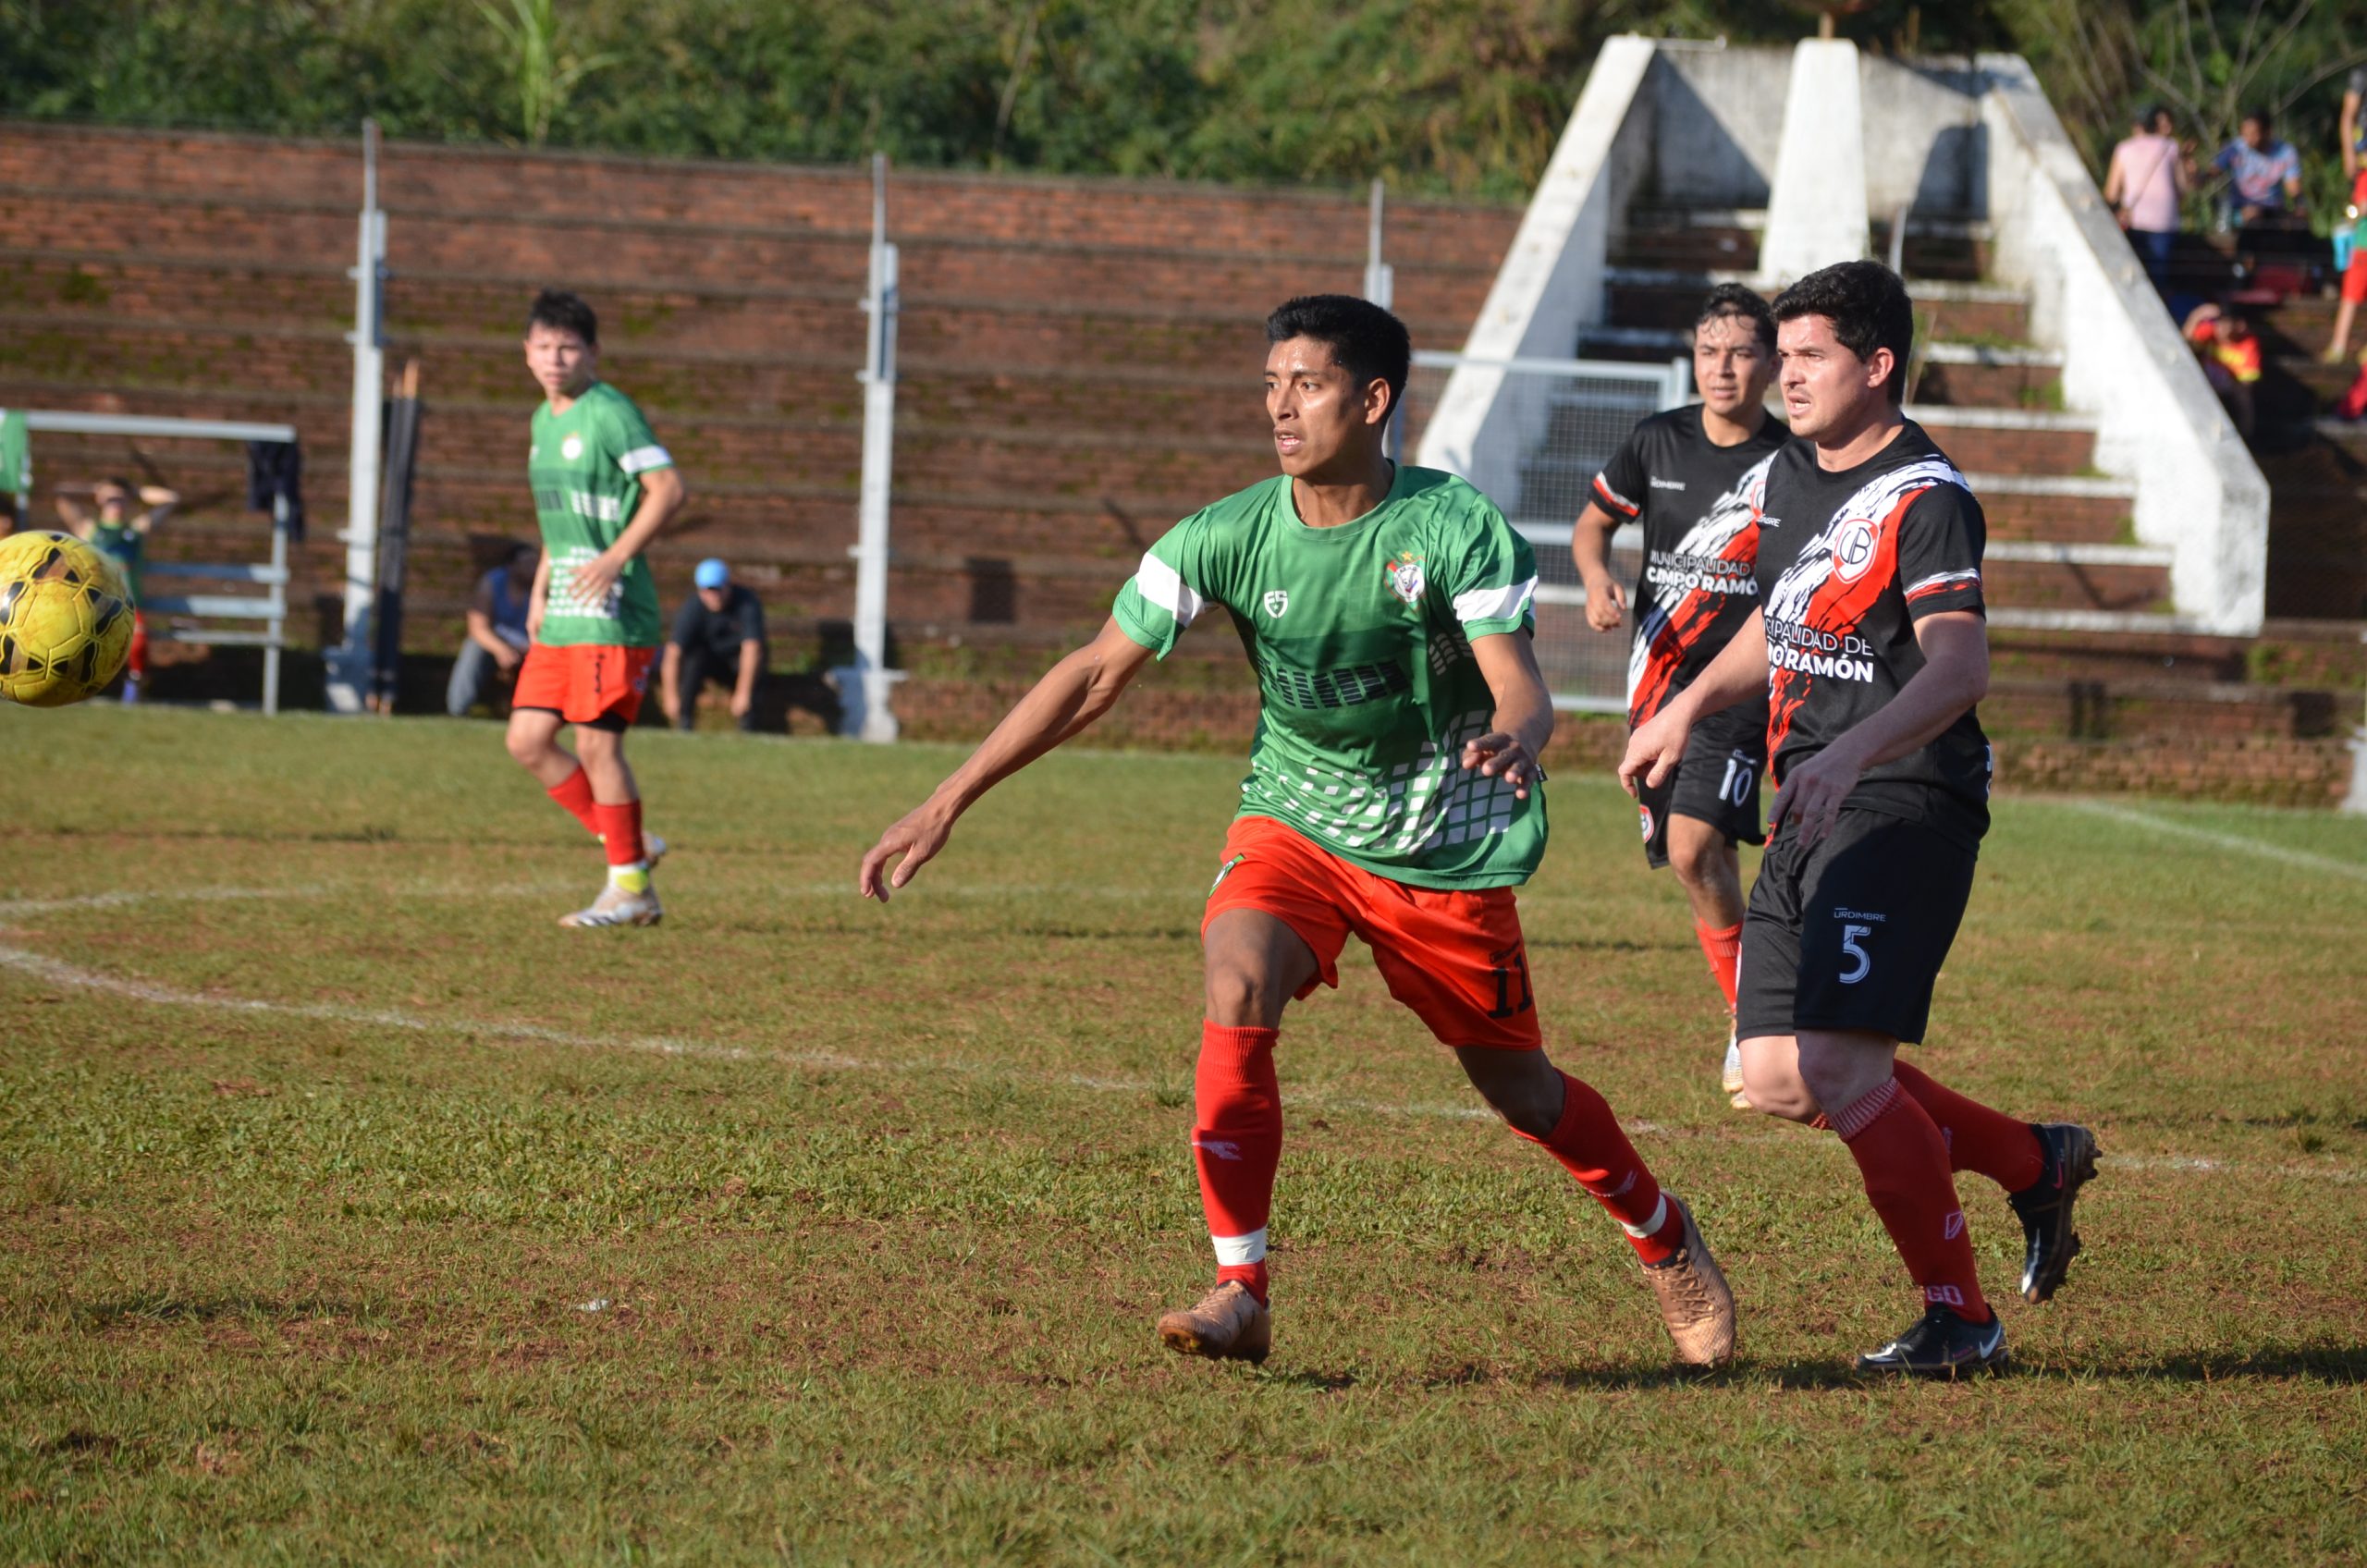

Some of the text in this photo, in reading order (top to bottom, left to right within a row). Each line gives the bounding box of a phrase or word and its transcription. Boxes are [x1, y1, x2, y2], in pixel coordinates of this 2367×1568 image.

[1650, 550, 1750, 576] MUNICIPALIDAD
[1647, 566, 1759, 595] CAMPO RAMÓ
[1846, 635, 1874, 656] DE
[1784, 648, 1874, 683] RAMÓN
[1719, 758, 1753, 808] 10
[1834, 907, 1886, 922] URDIMBRE
[1839, 925, 1871, 984] 5
[1488, 952, 1533, 1019] 11
